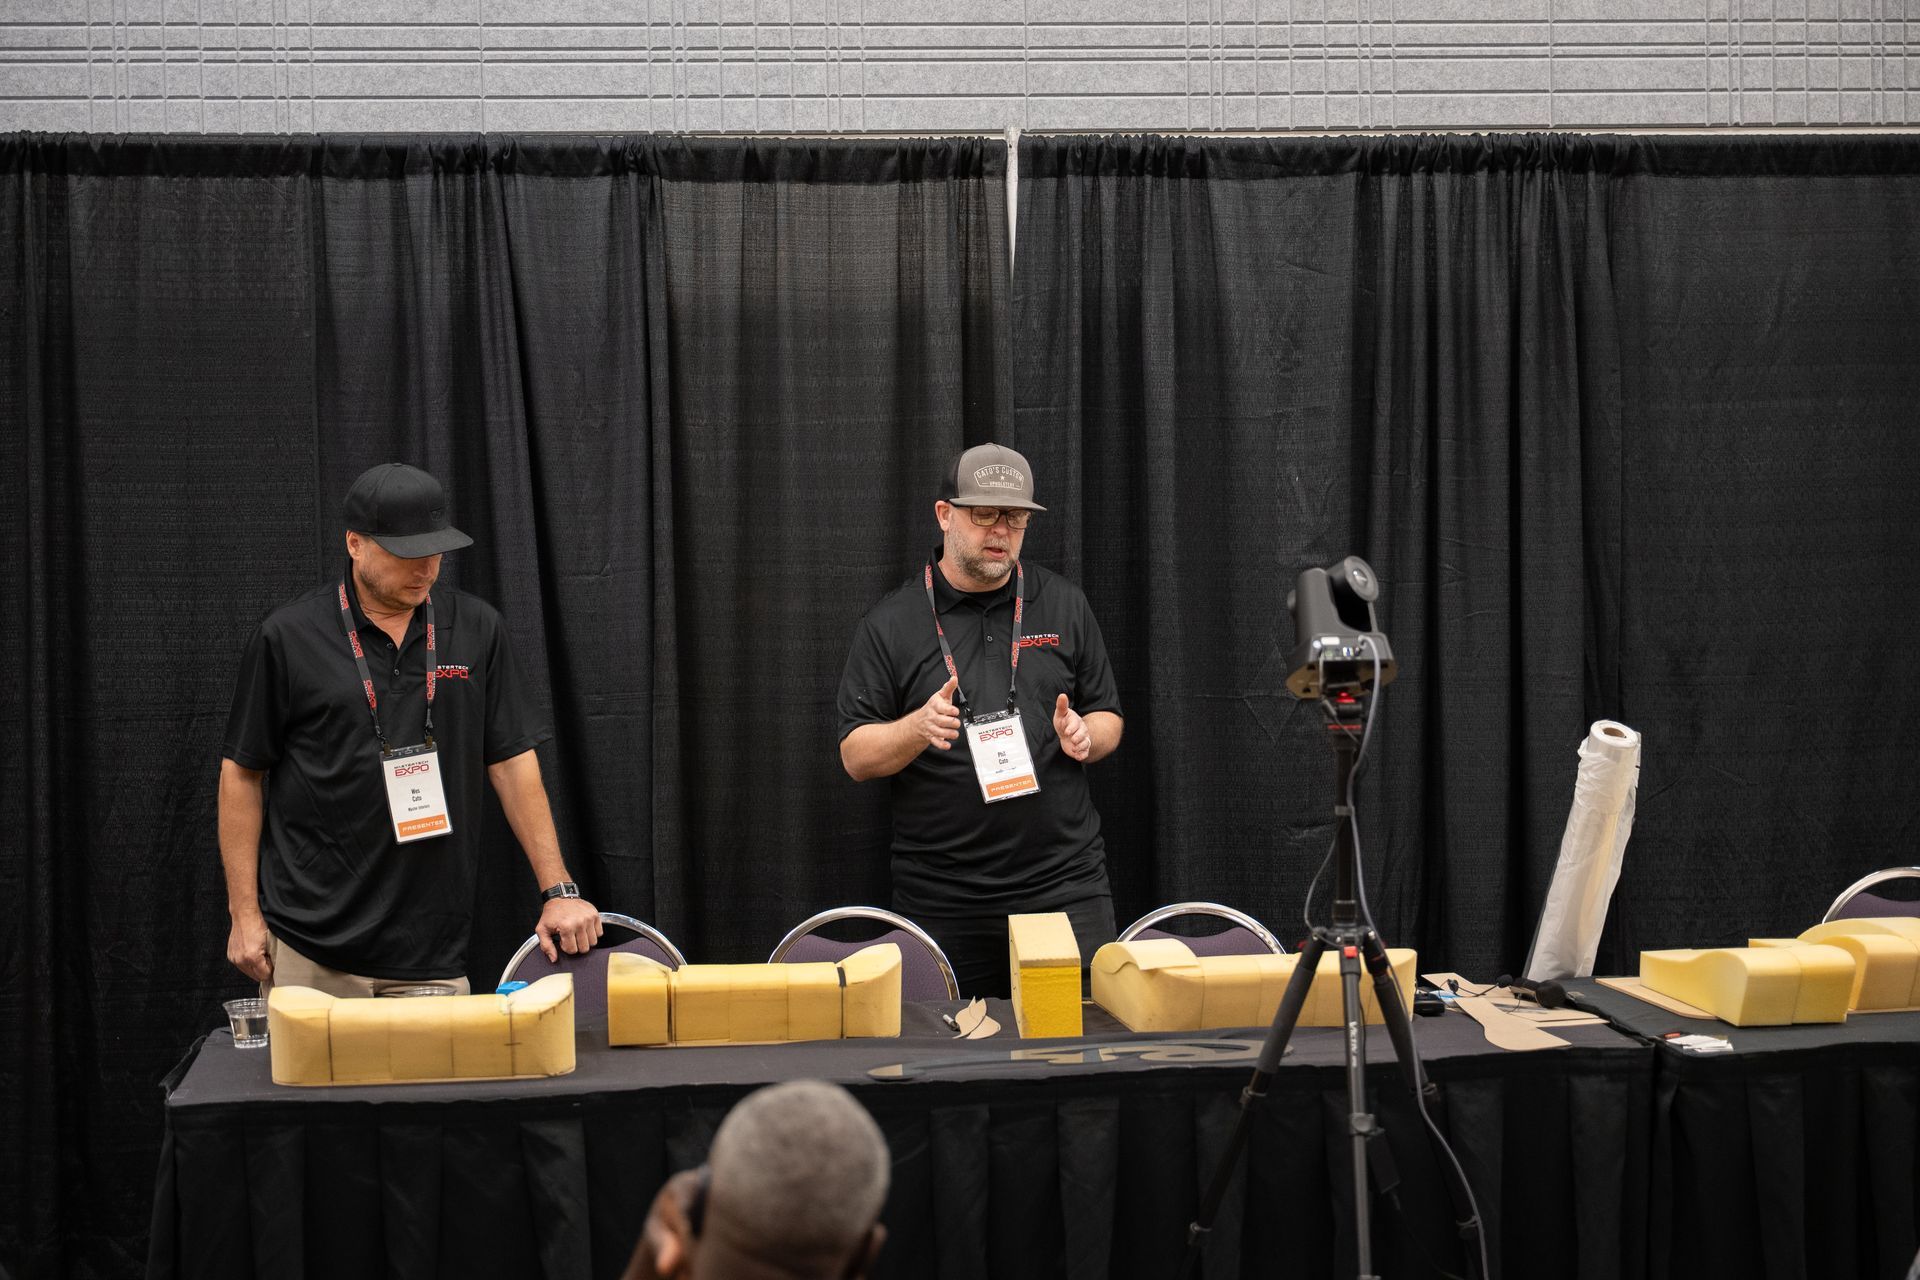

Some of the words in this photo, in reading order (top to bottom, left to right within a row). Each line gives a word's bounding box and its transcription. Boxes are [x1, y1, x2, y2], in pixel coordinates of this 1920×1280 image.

[350, 630, 364, 658] EXPO
[979, 728, 1014, 742] EXPO
[395, 764, 430, 777] EXPO
